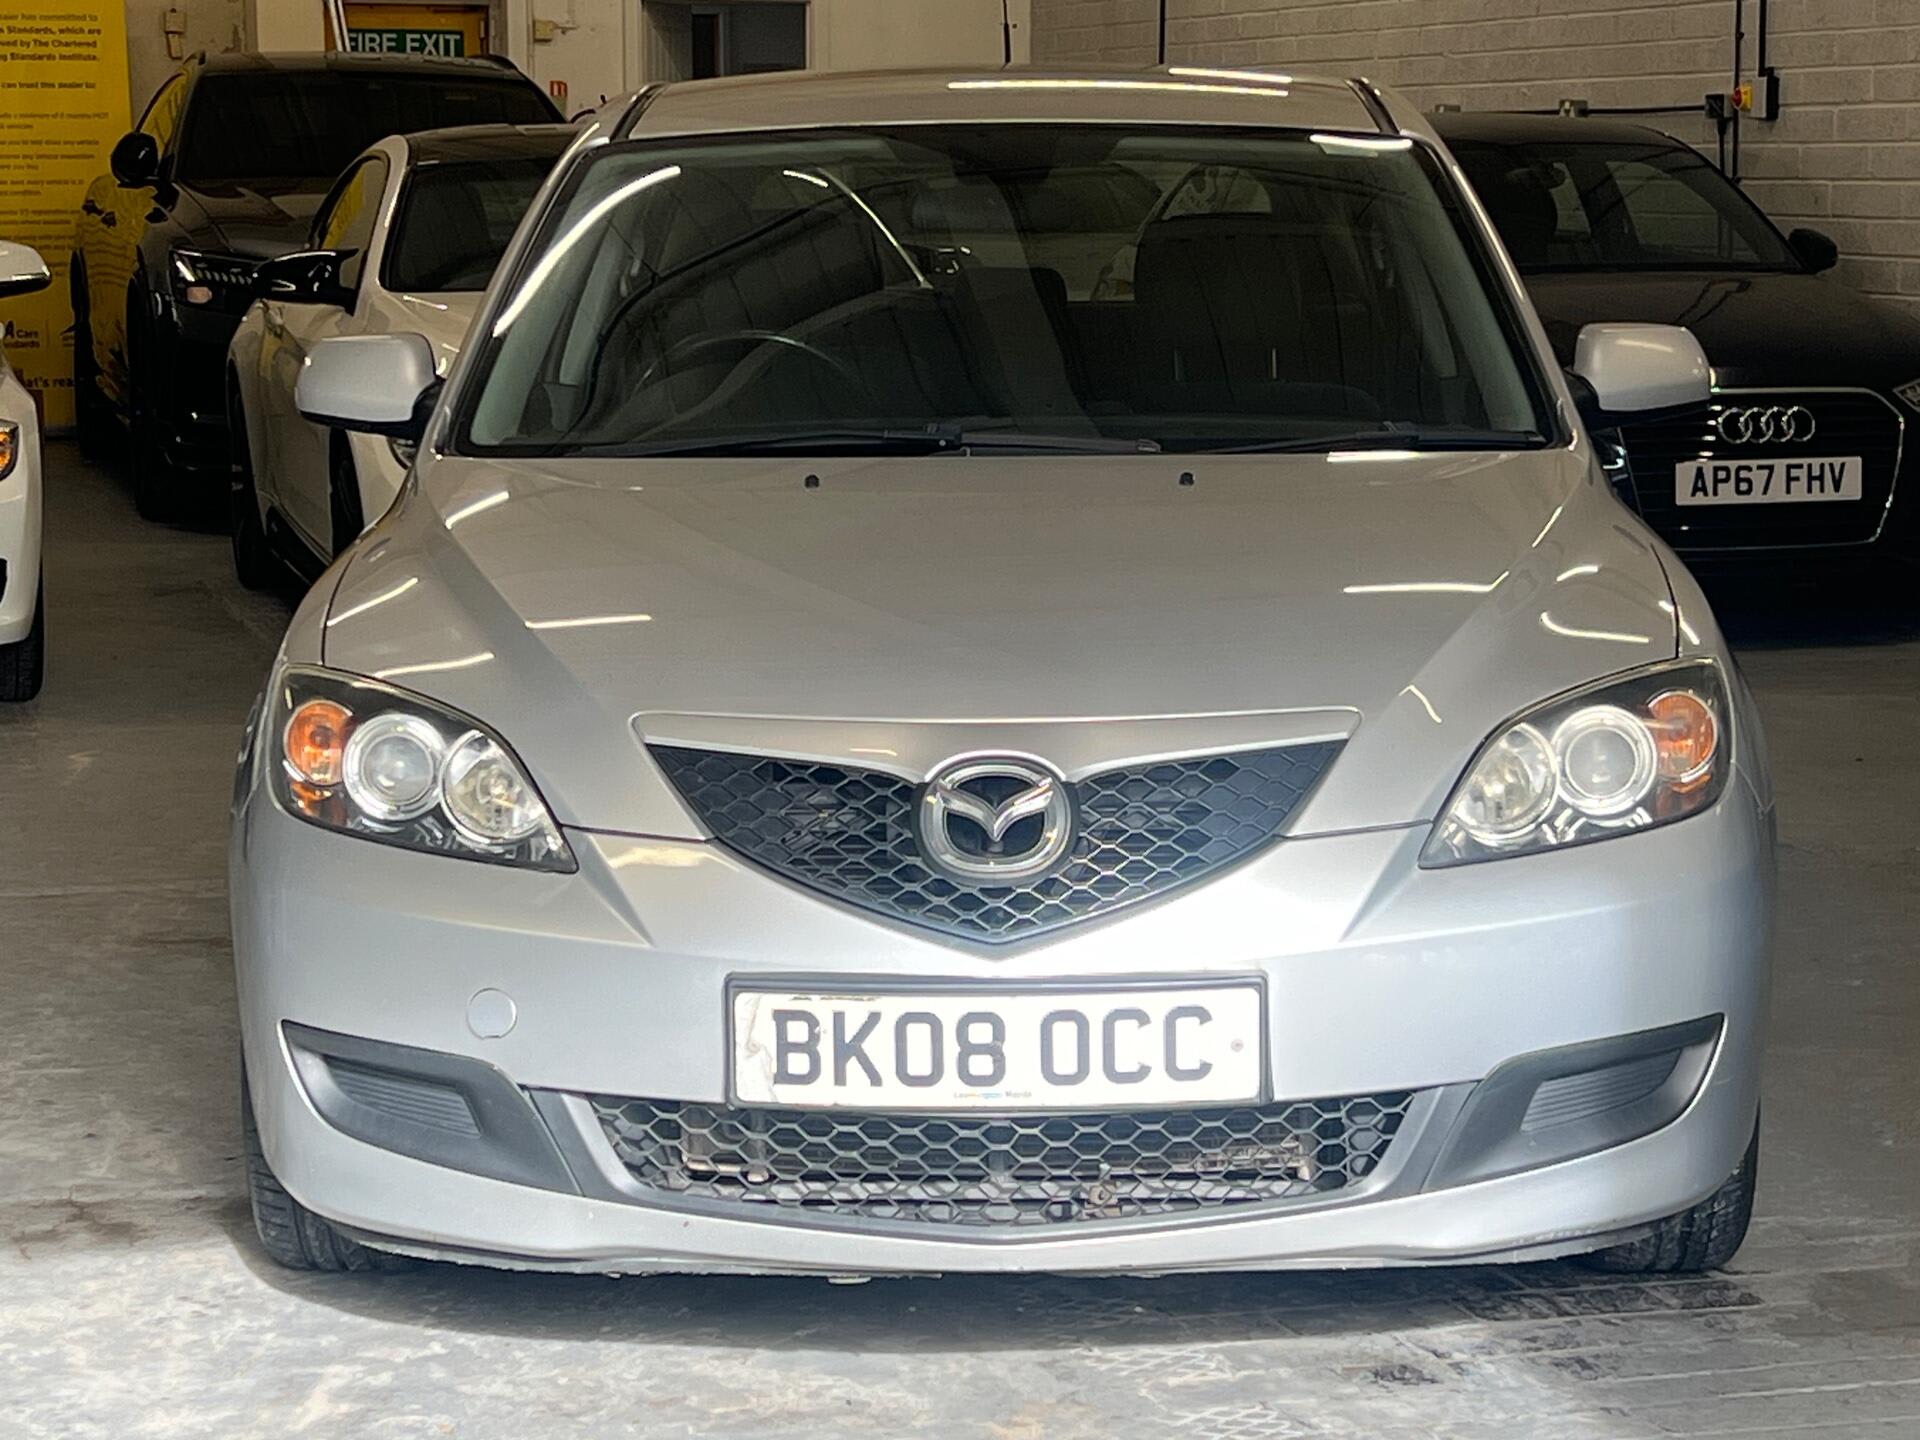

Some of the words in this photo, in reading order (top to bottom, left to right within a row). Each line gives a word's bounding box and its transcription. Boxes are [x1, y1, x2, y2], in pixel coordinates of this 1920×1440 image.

[10, 53, 56, 61] Standards
[406, 34, 461, 58] EXIT
[1690, 464, 1775, 498] AP67
[1785, 461, 1846, 495] FHV
[772, 1009, 1007, 1088] BK08
[1040, 1005, 1213, 1087] OCC
